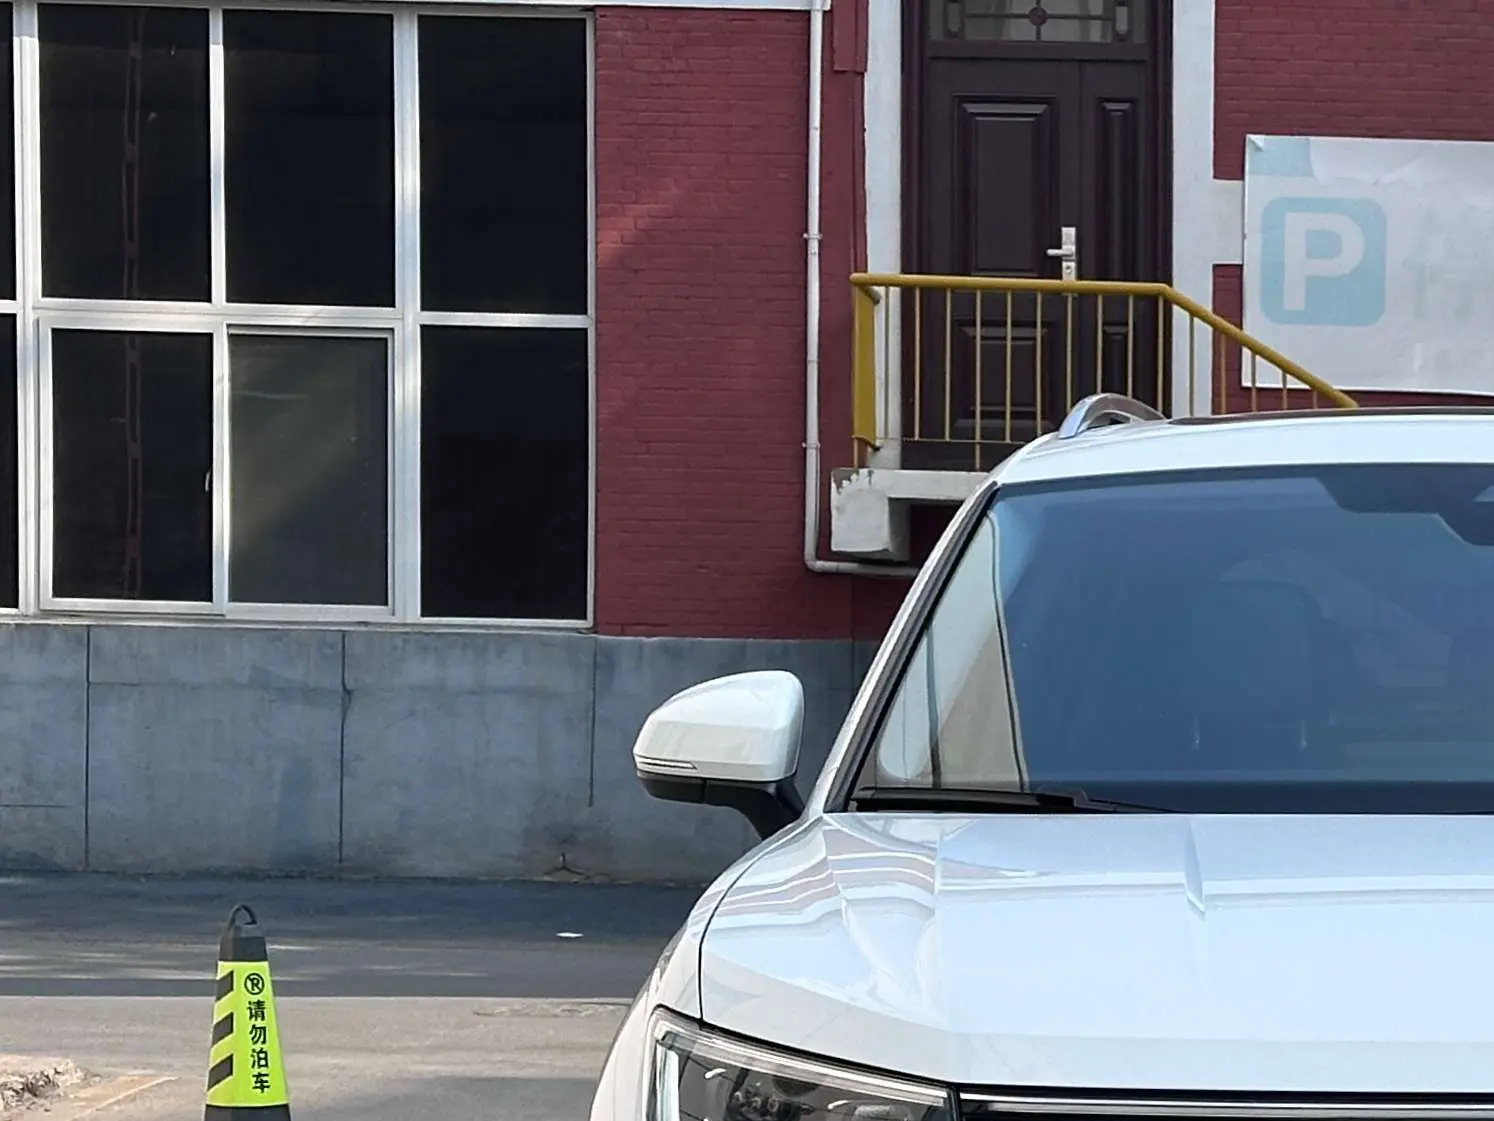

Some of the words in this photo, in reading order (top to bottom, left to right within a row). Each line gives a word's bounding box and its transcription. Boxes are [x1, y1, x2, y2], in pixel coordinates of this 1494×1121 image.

[1283, 211, 1365, 311] P
[247, 1000, 271, 1093] 请勿泊车
